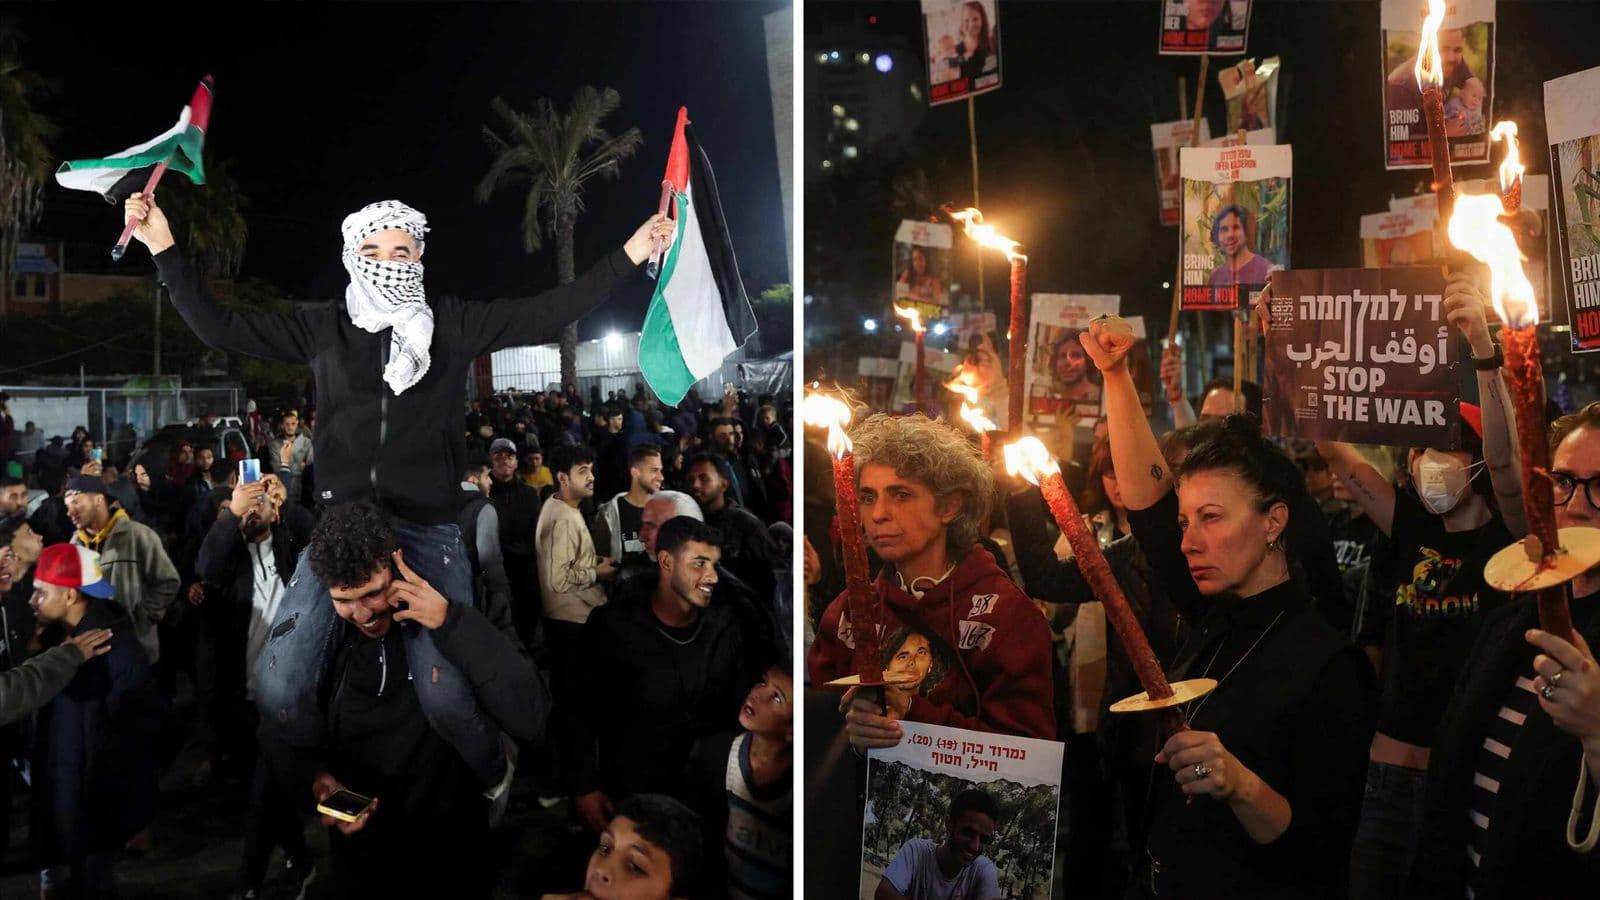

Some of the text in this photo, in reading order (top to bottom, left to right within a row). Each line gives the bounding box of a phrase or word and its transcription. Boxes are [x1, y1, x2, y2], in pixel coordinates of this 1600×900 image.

[1389, 108, 1419, 124] BRING
[1390, 125, 1409, 140] HIM
[1391, 142, 1416, 157] HOME
[1184, 254, 1215, 269] BRING
[1571, 254, 1600, 283] BRI
[1184, 270, 1203, 286] HIM
[1184, 287, 1212, 303] HOME
[1300, 289, 1442, 321] די למלחמה
[1577, 310, 1600, 338] HO
[1286, 322, 1449, 375] أوقف الحرب
[1323, 365, 1386, 393] STOP
[1323, 394, 1447, 426] THE WAR
[962, 741, 983, 755] כהן
[989, 745, 1026, 760] נמרוד
[931, 751, 998, 772] חייל, חטוף
